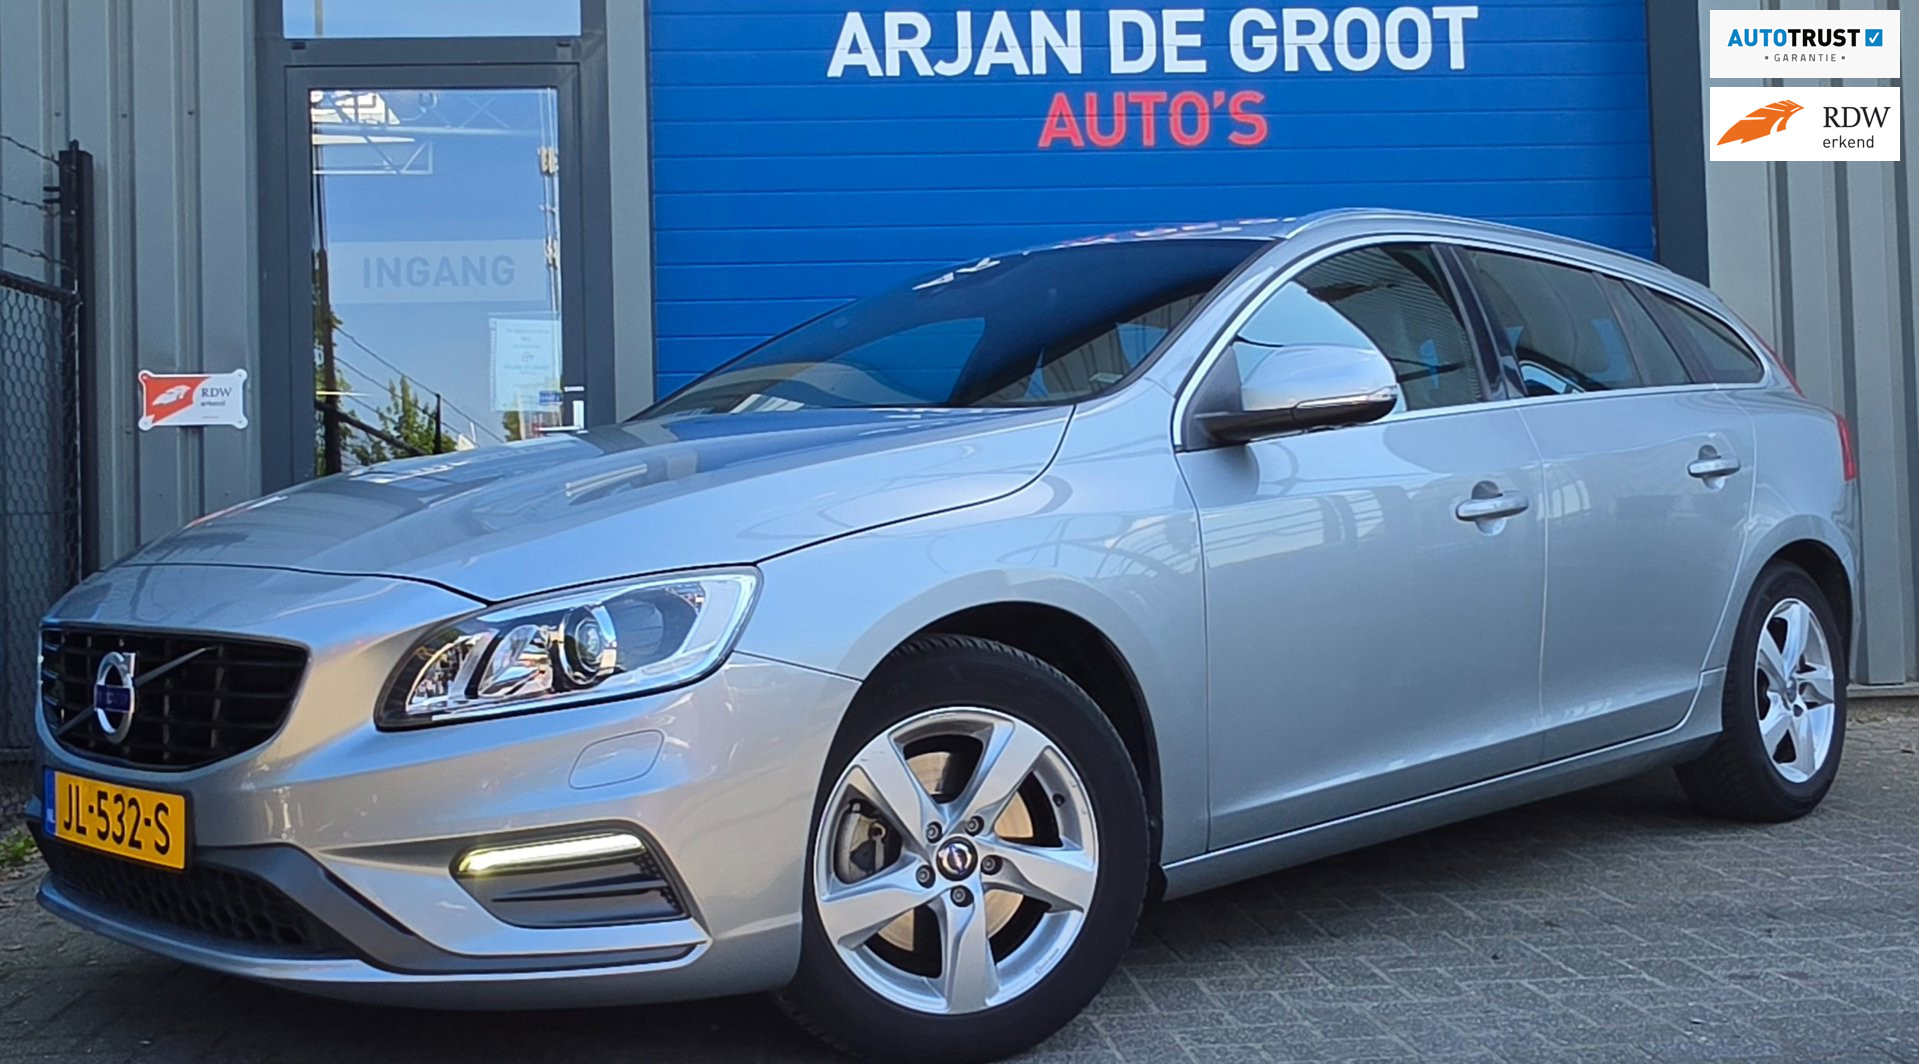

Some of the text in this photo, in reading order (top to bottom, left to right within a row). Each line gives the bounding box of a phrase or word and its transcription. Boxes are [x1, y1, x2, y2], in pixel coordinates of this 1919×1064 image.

[827, 6, 1479, 78] ARJAN DE GROOT
[1038, 90, 1269, 149] AUTO'S
[362, 254, 516, 289] INGANG
[201, 387, 232, 398] RDW
[63, 783, 171, 856] JL-532-S
